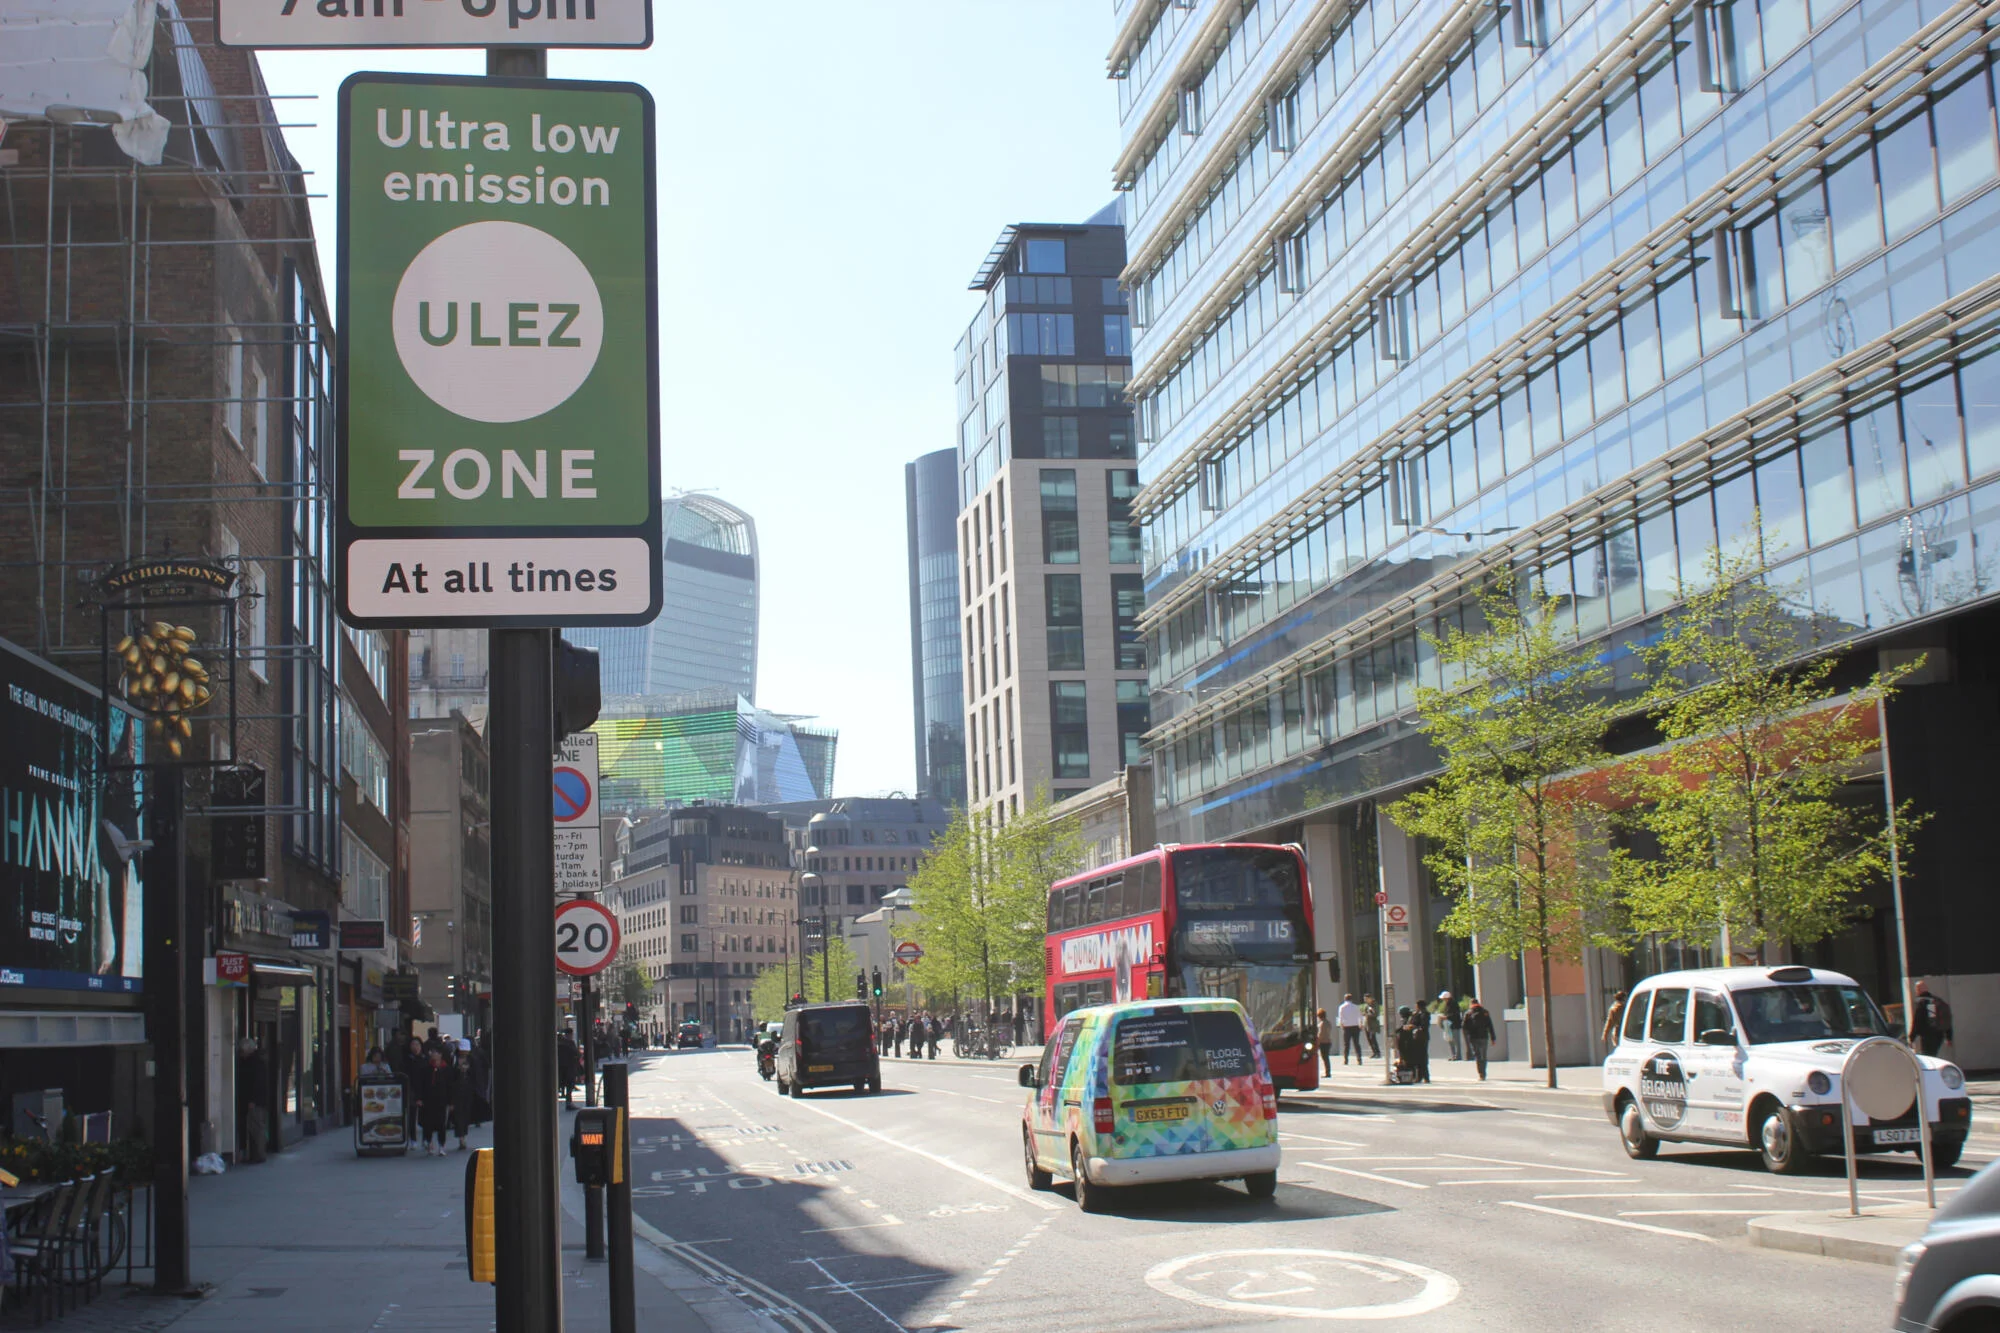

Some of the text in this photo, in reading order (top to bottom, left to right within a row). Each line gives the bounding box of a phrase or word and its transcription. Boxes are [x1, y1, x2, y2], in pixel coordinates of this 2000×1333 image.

[377, 108, 620, 154] Ultra low
[384, 163, 610, 206] emission
[419, 301, 582, 348] ULEZ
[398, 448, 597, 500] ZONE
[382, 561, 617, 594] At all times
[9, 683, 22, 705] THE
[23, 690, 38, 712] GIRL
[39, 697, 48, 716] NO
[49, 702, 62, 722] ONE
[2, 786, 101, 885] HANNA
[570, 832, 582, 840] Fri
[568, 842, 588, 851] 7pm
[556, 852, 585, 861] turday
[563, 880, 599, 888] holidays
[556, 922, 608, 953] 20
[1193, 921, 1290, 938] East Ham 115
[291, 933, 319, 948] HILL
[222, 957, 244, 968] JUST
[226, 964, 244, 975] EAT
[1206, 1048, 1246, 1060] FLORAL
[1207, 1058, 1241, 1070] IMAGE
[1656, 1059, 1670, 1075] THE
[1642, 1080, 1686, 1099] BELGRAVIA
[1136, 1108, 1166, 1121] GX63
[1652, 1103, 1680, 1120] CENTRE
[581, 1133, 604, 1145] WAIT
[1878, 1130, 1907, 1142] LS07
[651, 1162, 785, 1181] BUS
